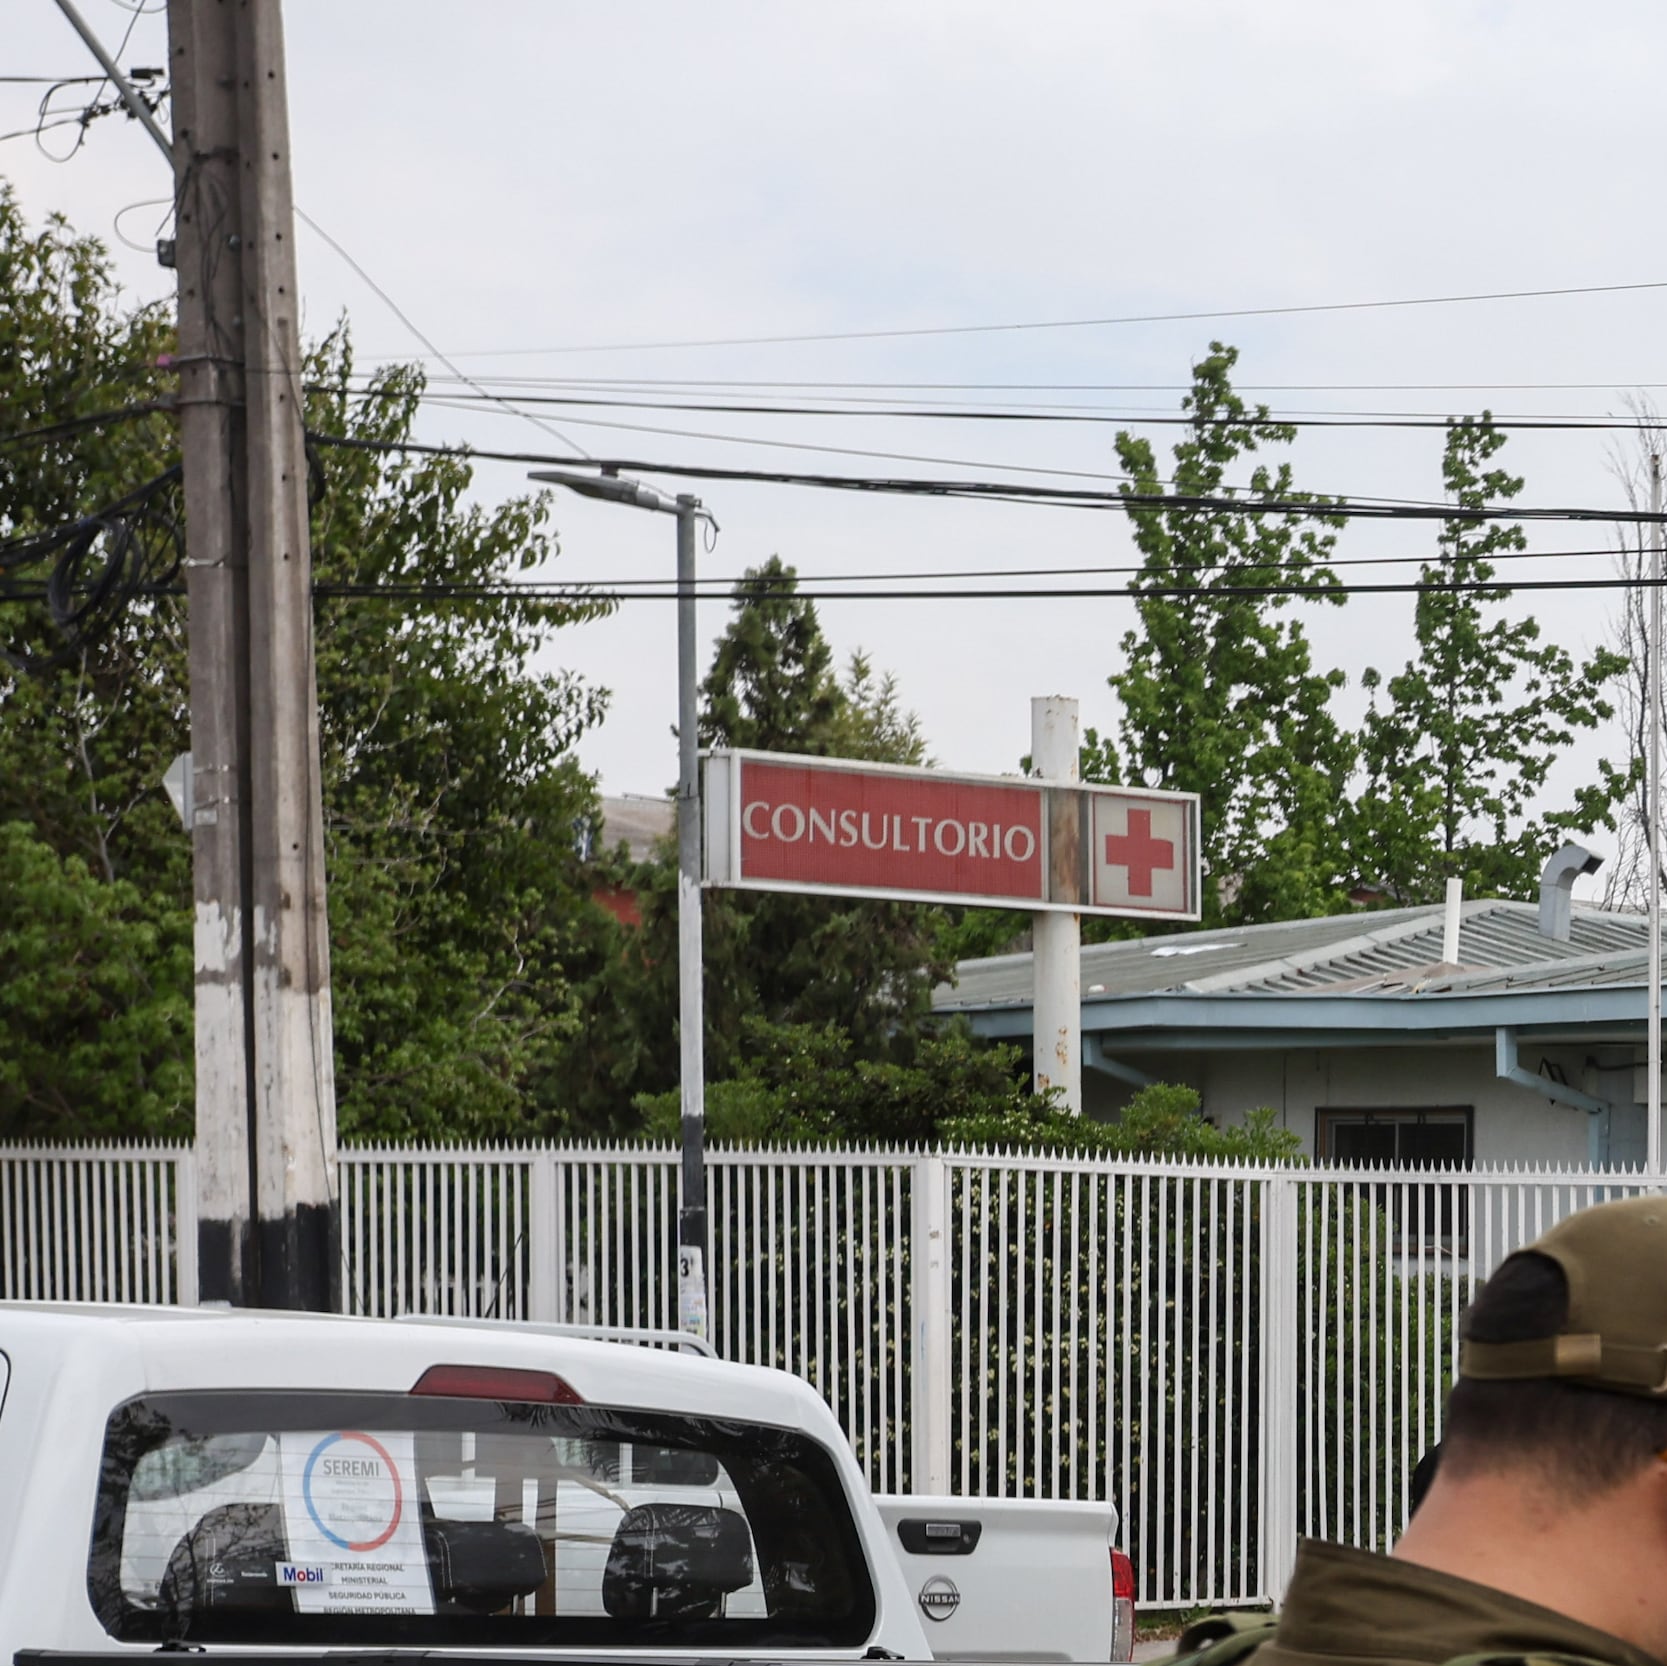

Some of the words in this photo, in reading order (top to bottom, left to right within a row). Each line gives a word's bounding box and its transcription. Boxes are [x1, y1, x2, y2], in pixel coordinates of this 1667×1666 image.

[743, 801, 1036, 862] CONSULTORIO
[323, 1459, 380, 1477] SEREMI
[366, 1563, 405, 1572] REGIONAL
[283, 1566, 324, 1583] Mobil
[341, 1576, 388, 1585] MINISTERIAL
[328, 1591, 373, 1600] SEGURIDAD
[374, 1590, 406, 1600] PÚBLICA
[920, 1594, 960, 1604] NISSAN
